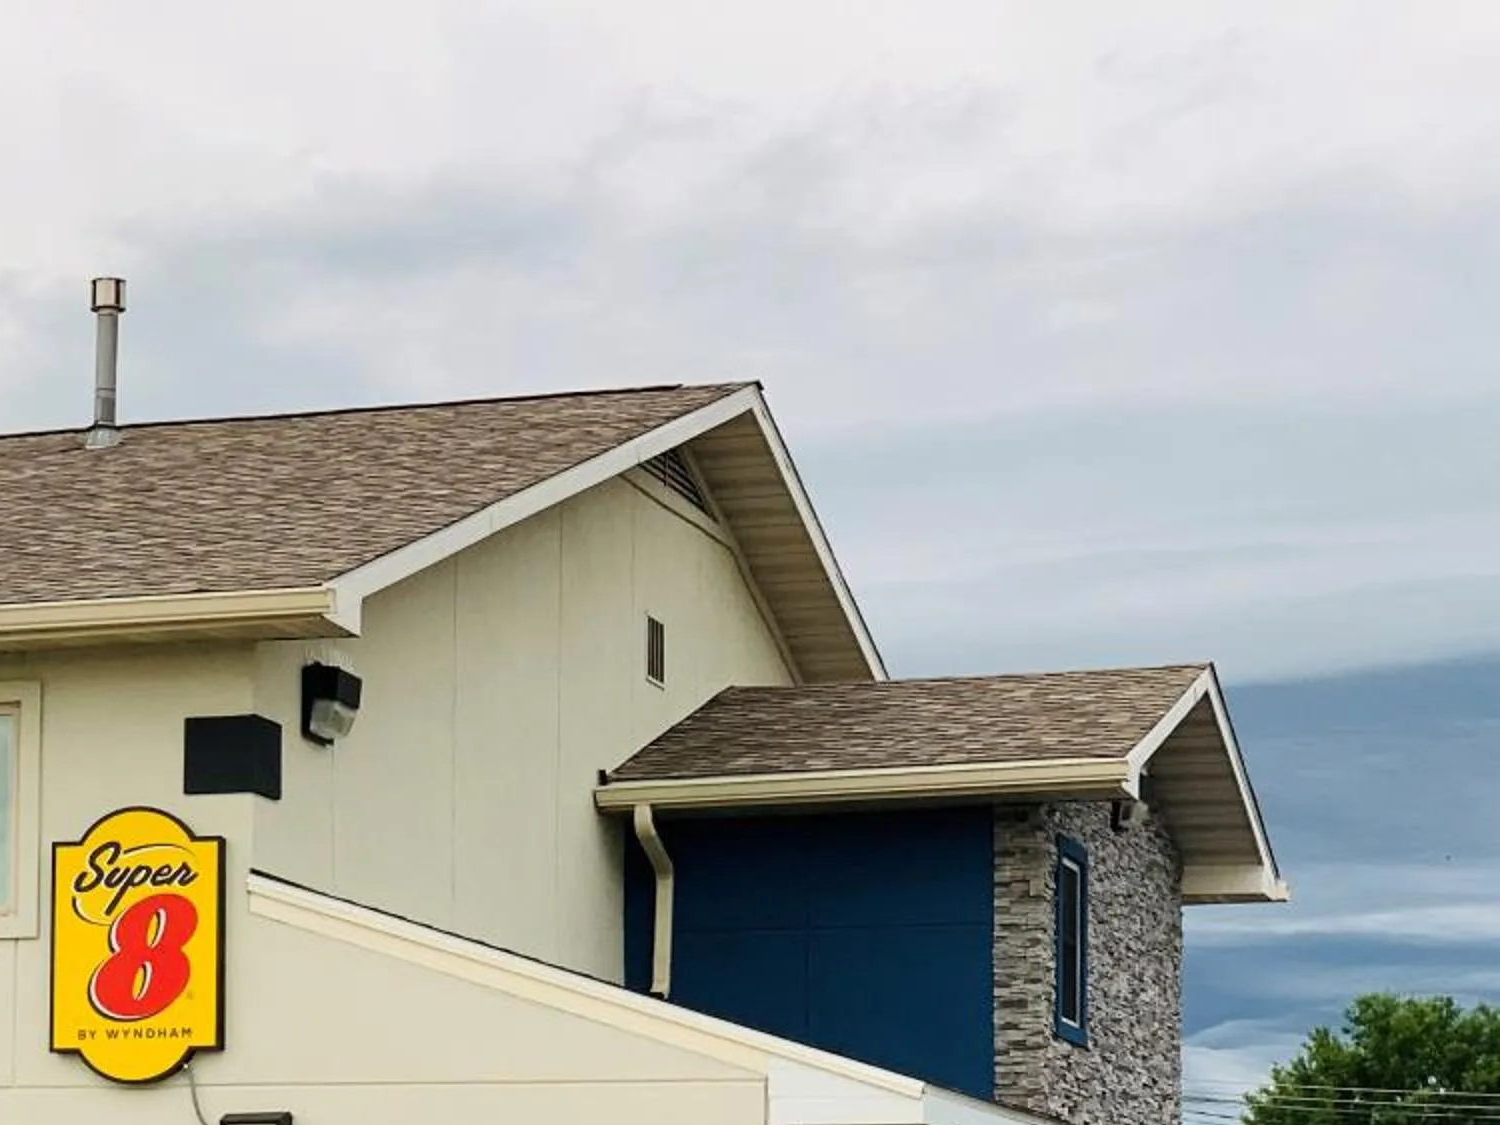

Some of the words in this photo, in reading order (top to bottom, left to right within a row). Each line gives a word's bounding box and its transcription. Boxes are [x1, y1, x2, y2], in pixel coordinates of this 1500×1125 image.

[73, 841, 199, 917] Super
[87, 893, 199, 1022] 8
[77, 1029, 96, 1040] BY
[106, 1027, 193, 1040] WYNDHAM
